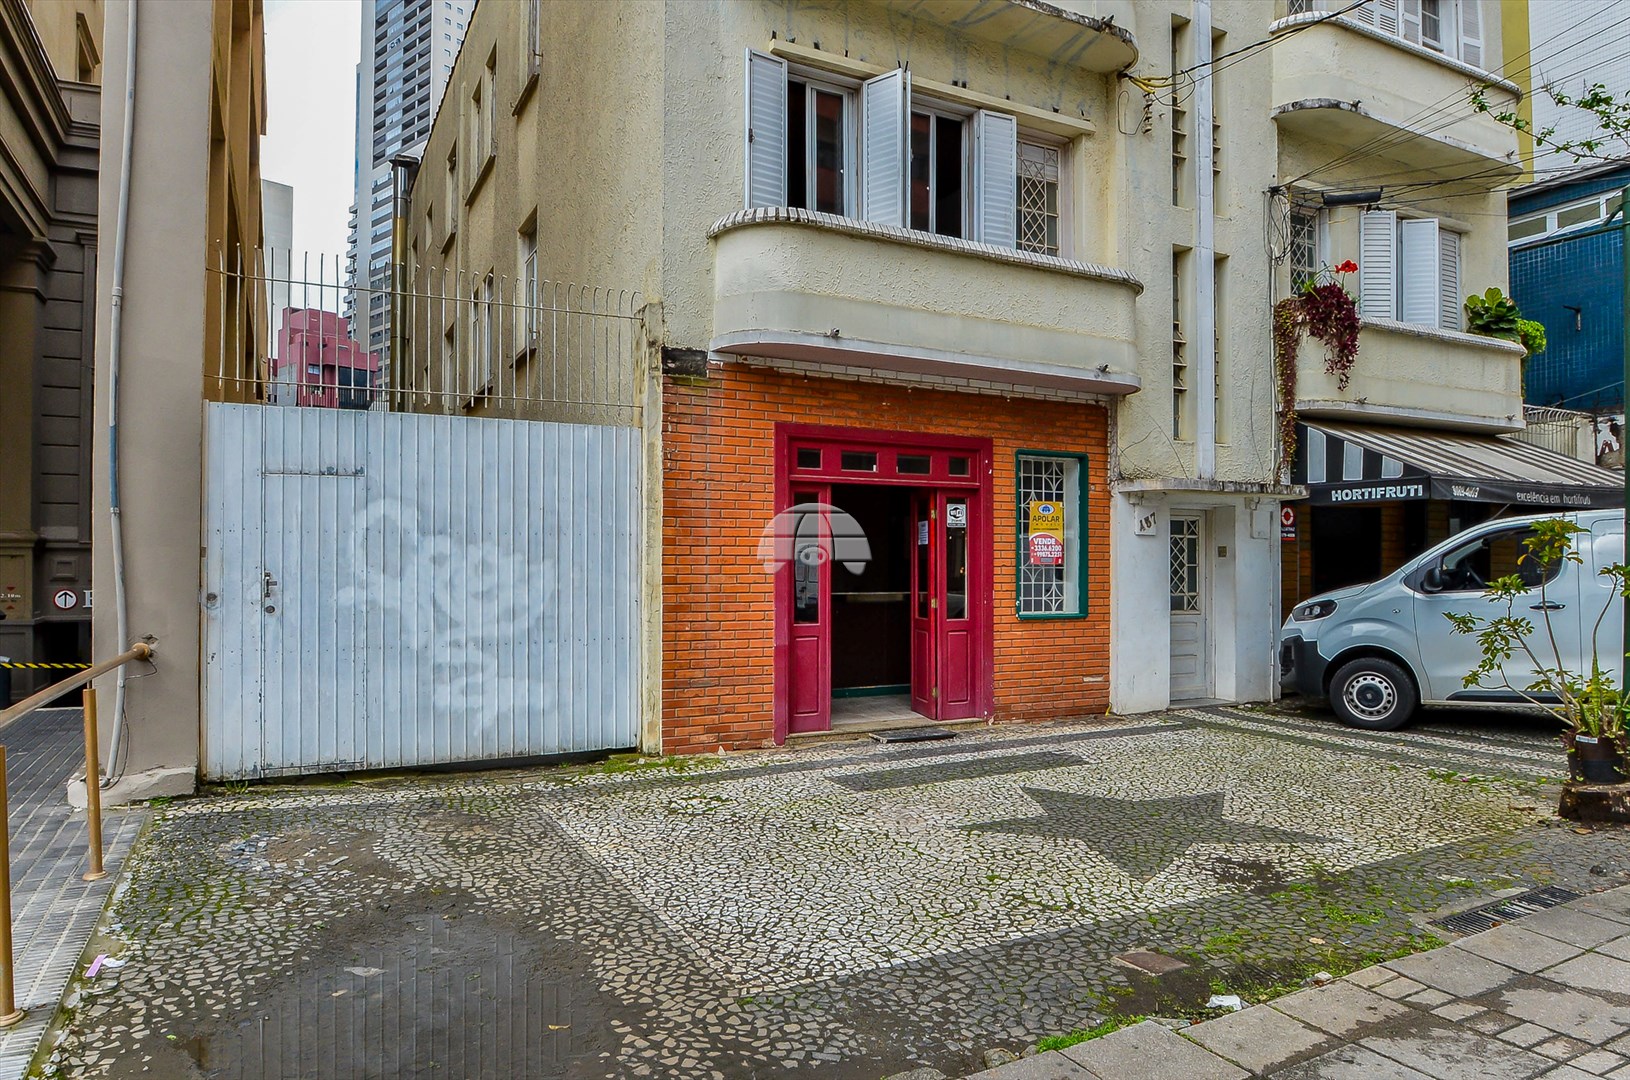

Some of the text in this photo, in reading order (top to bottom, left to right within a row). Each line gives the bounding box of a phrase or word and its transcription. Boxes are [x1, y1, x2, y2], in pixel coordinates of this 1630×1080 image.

[1331, 485, 1423, 501] HORTIFRUTI
[1550, 494, 1561, 504] em
[1032, 515, 1060, 523] APOLAR
[1033, 537, 1056, 545] VENDE
